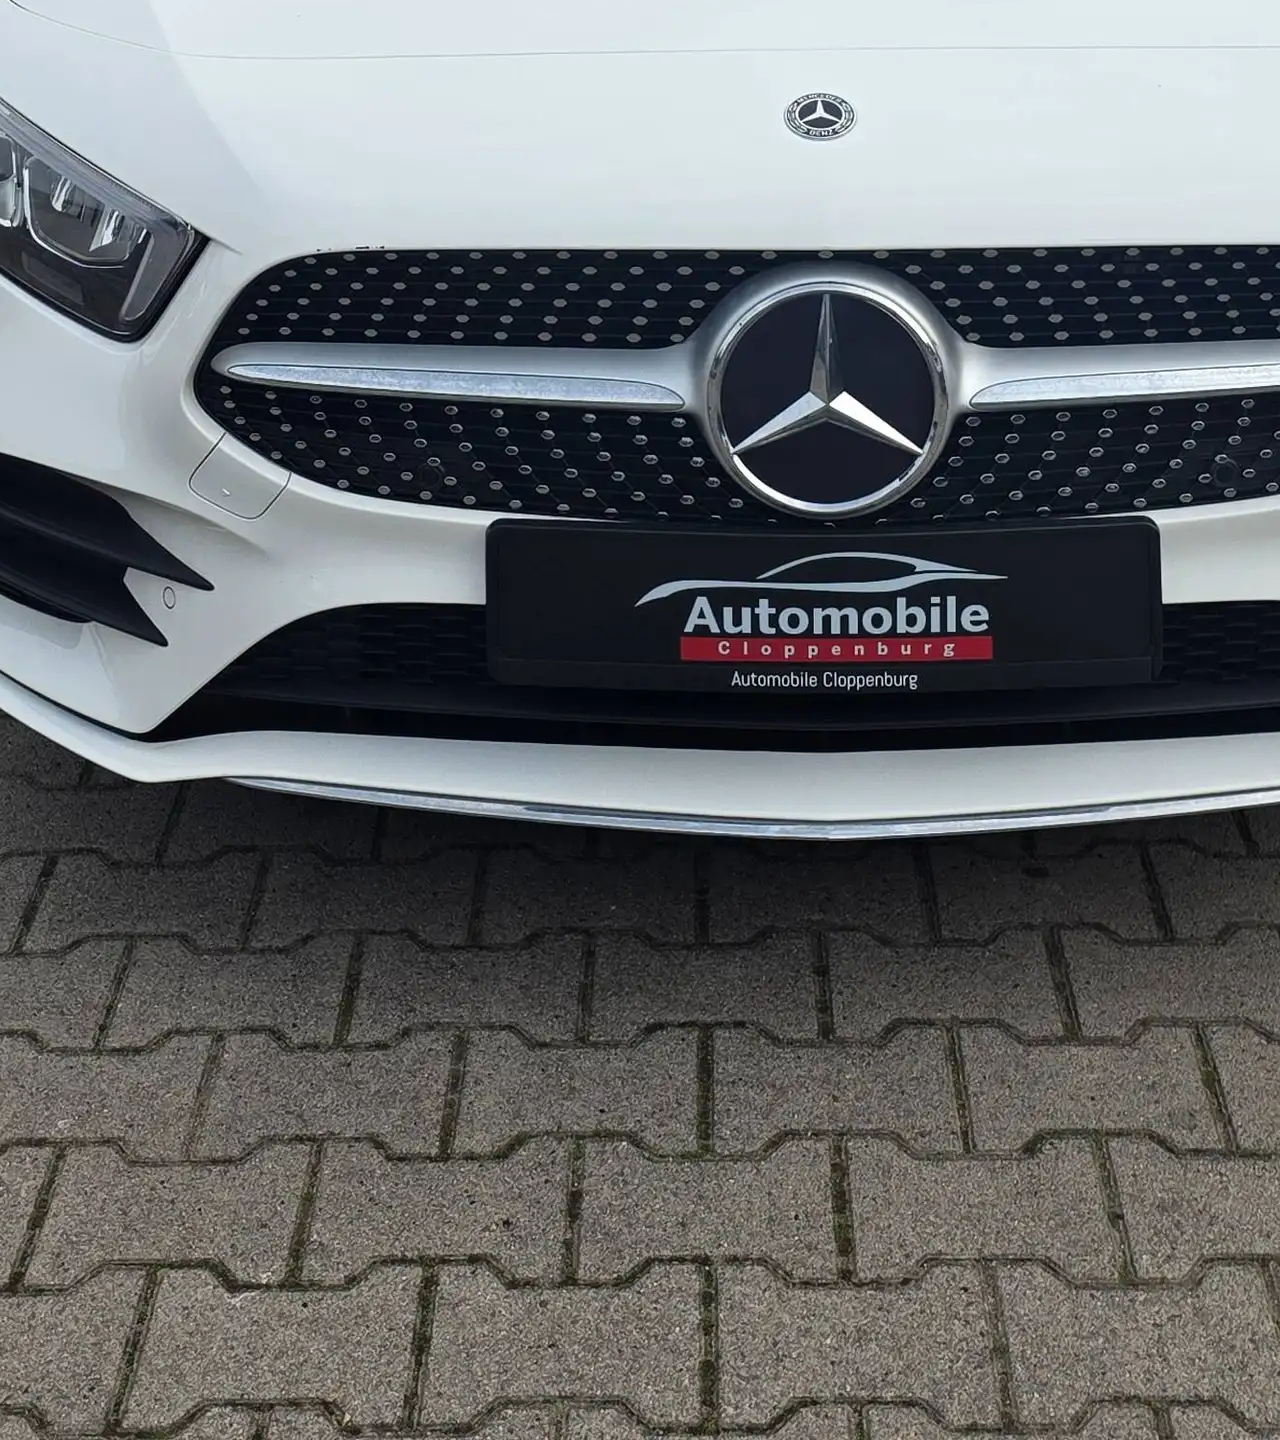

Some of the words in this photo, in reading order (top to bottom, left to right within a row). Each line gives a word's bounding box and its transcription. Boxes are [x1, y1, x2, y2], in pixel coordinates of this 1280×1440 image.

[683, 595, 990, 635] Automobile
[717, 641, 956, 659] Cloppenburg
[730, 670, 818, 688] Automobile
[823, 671, 918, 690] Cloppenburg
